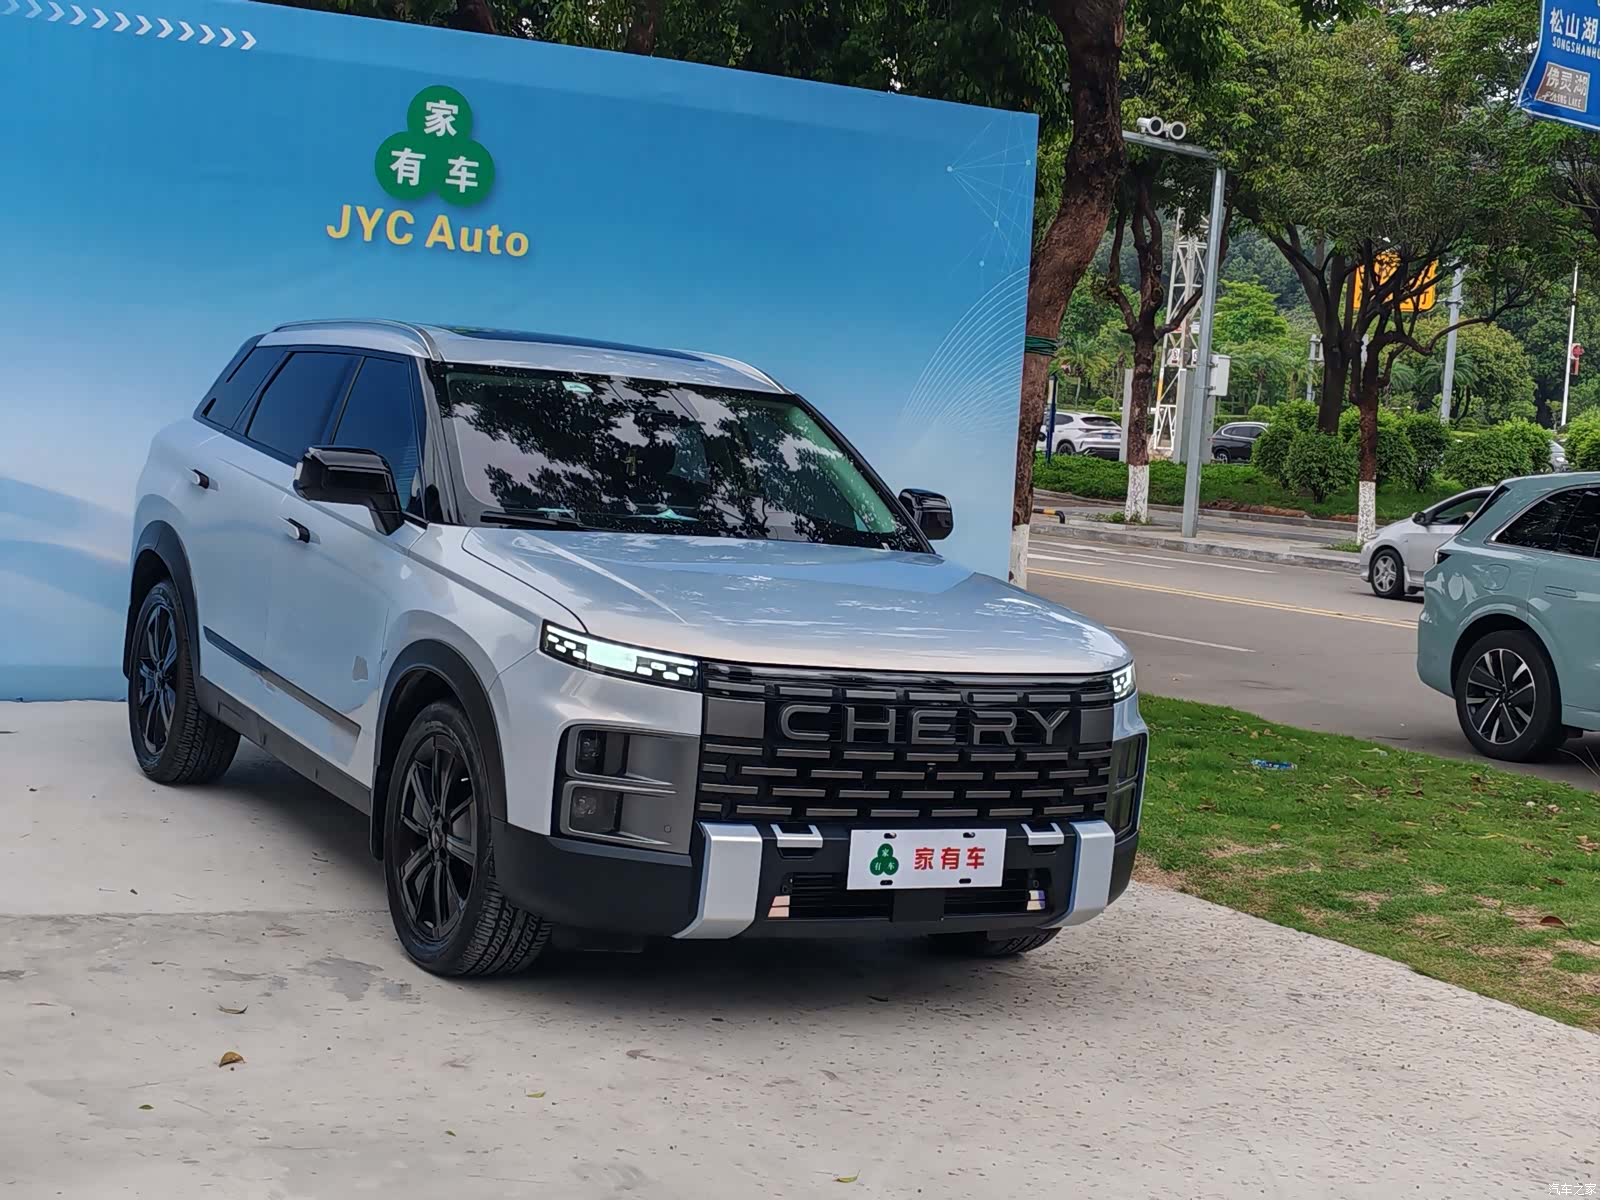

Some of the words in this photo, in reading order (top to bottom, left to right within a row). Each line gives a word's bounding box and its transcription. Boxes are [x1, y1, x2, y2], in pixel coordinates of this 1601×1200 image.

[423, 99, 459, 137] 家
[327, 203, 415, 246] JYC
[424, 214, 529, 257] Auto
[778, 703, 1071, 746] CHERY
[913, 846, 986, 871] 家有车
